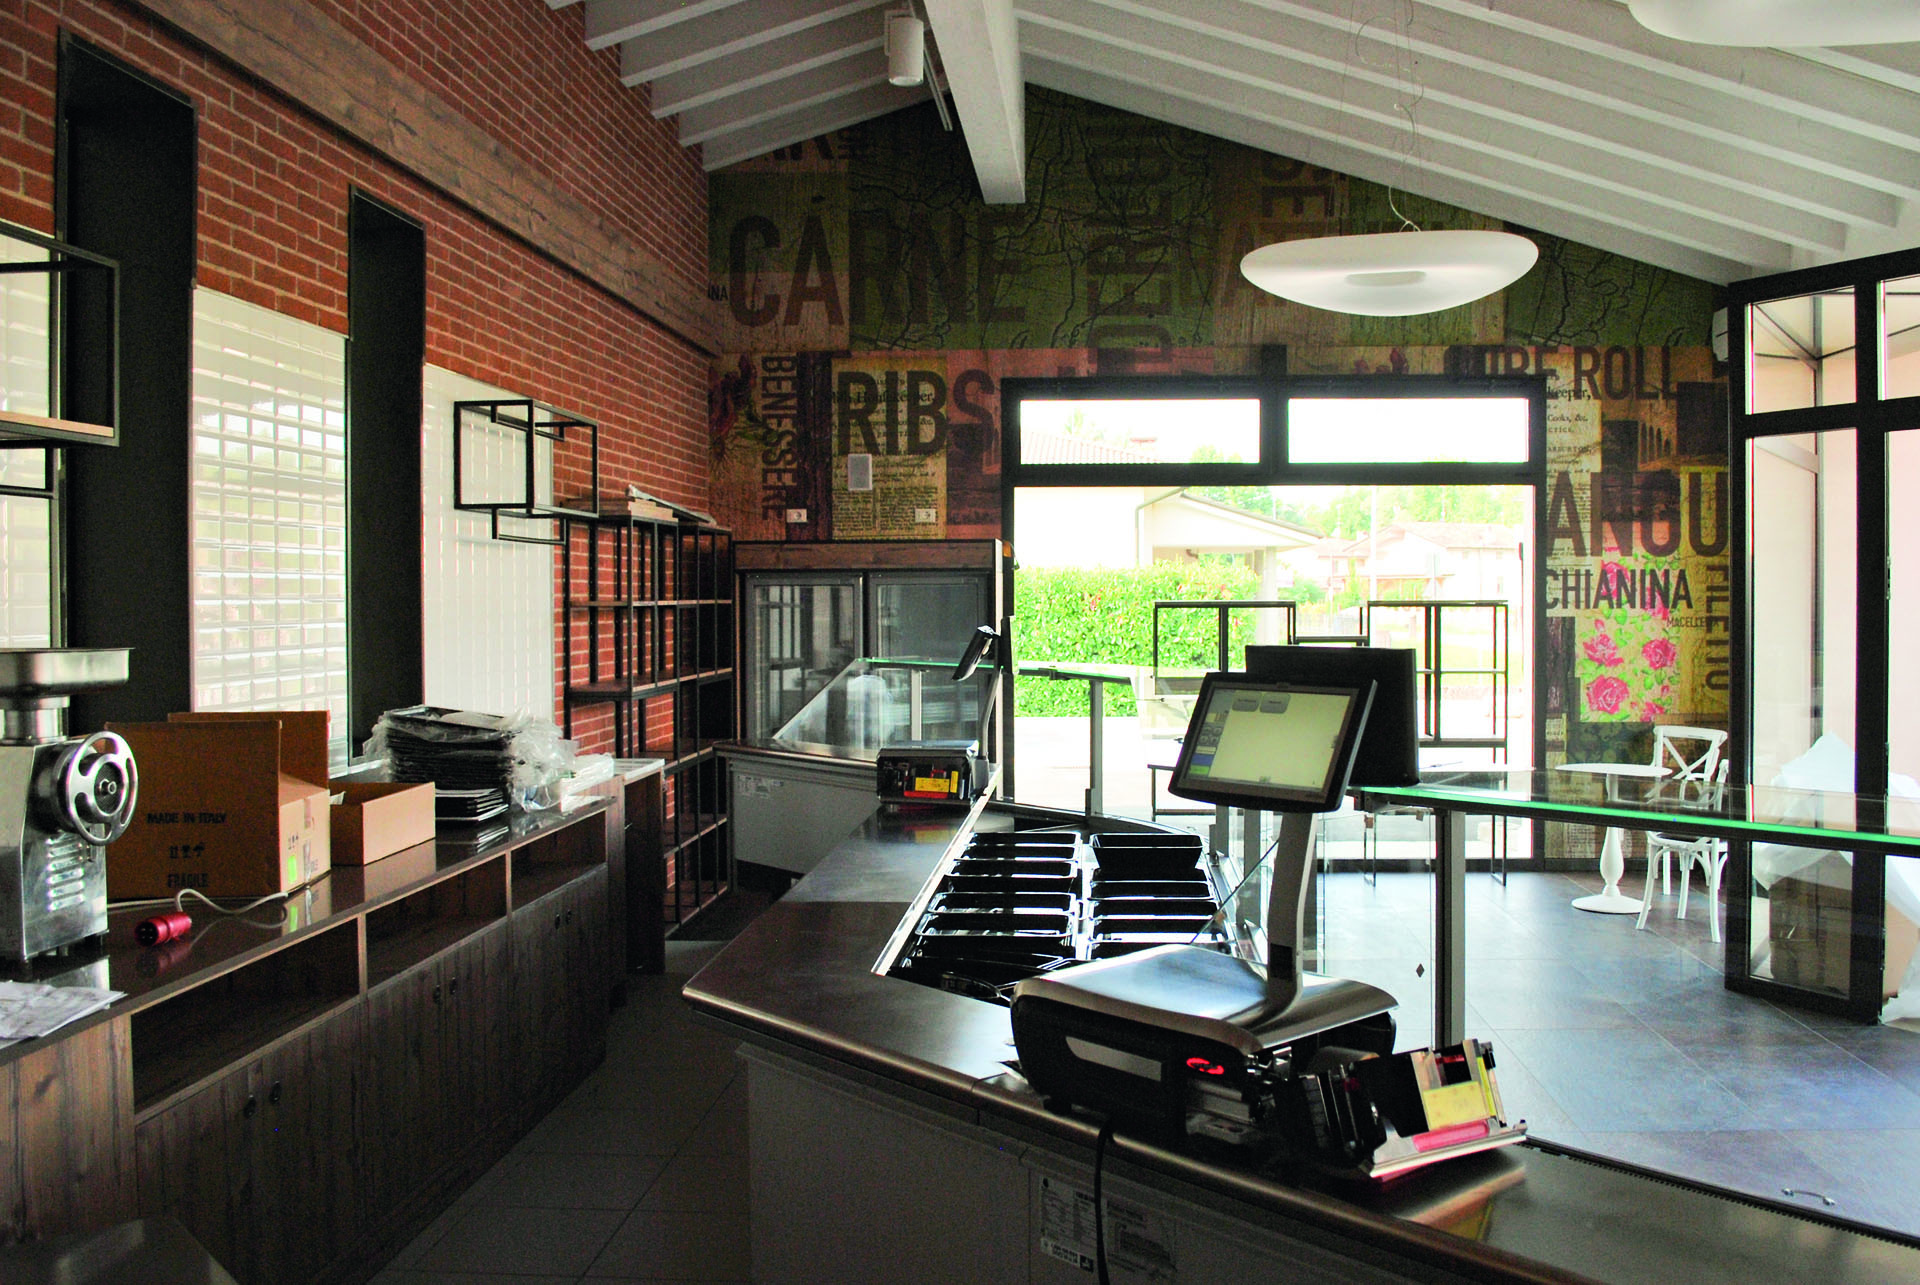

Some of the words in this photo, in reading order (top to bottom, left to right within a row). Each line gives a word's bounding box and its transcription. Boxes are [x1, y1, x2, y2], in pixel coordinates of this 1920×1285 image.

[729, 214, 1026, 326] CARNE
[1574, 346, 1678, 401] ROLL
[838, 369, 995, 456] RIBS
[1546, 569, 1693, 609] CHIANINA
[147, 812, 179, 824] MADE
[183, 812, 195, 823] IN
[198, 812, 227, 823] ITALY
[168, 873, 208, 888] FRAGILE
